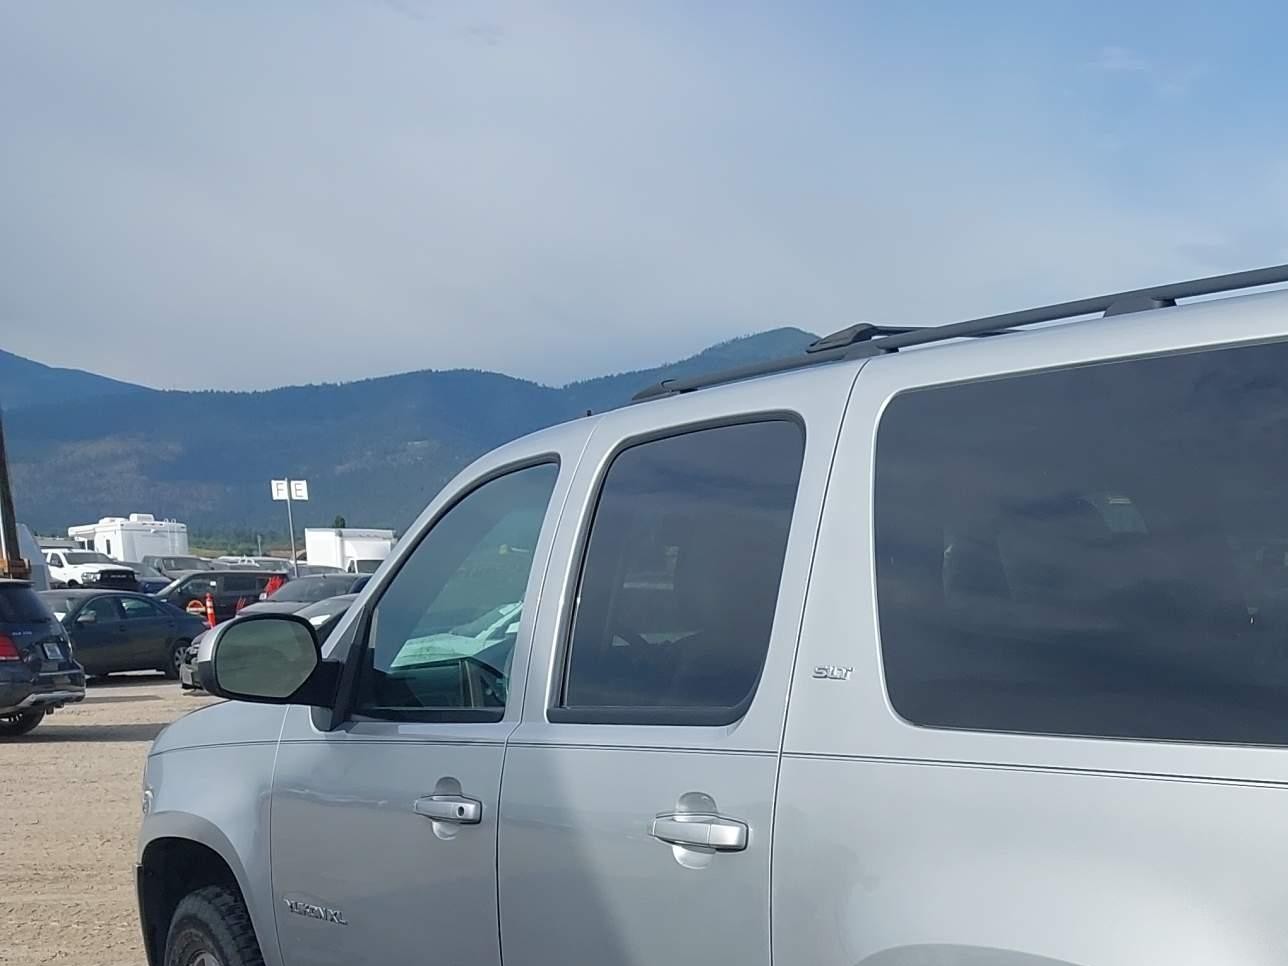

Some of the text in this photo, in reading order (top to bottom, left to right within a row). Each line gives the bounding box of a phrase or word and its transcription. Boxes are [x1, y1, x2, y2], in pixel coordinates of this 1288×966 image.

[276, 482, 284, 497] F
[295, 483, 305, 497] E
[811, 665, 854, 680] SLT
